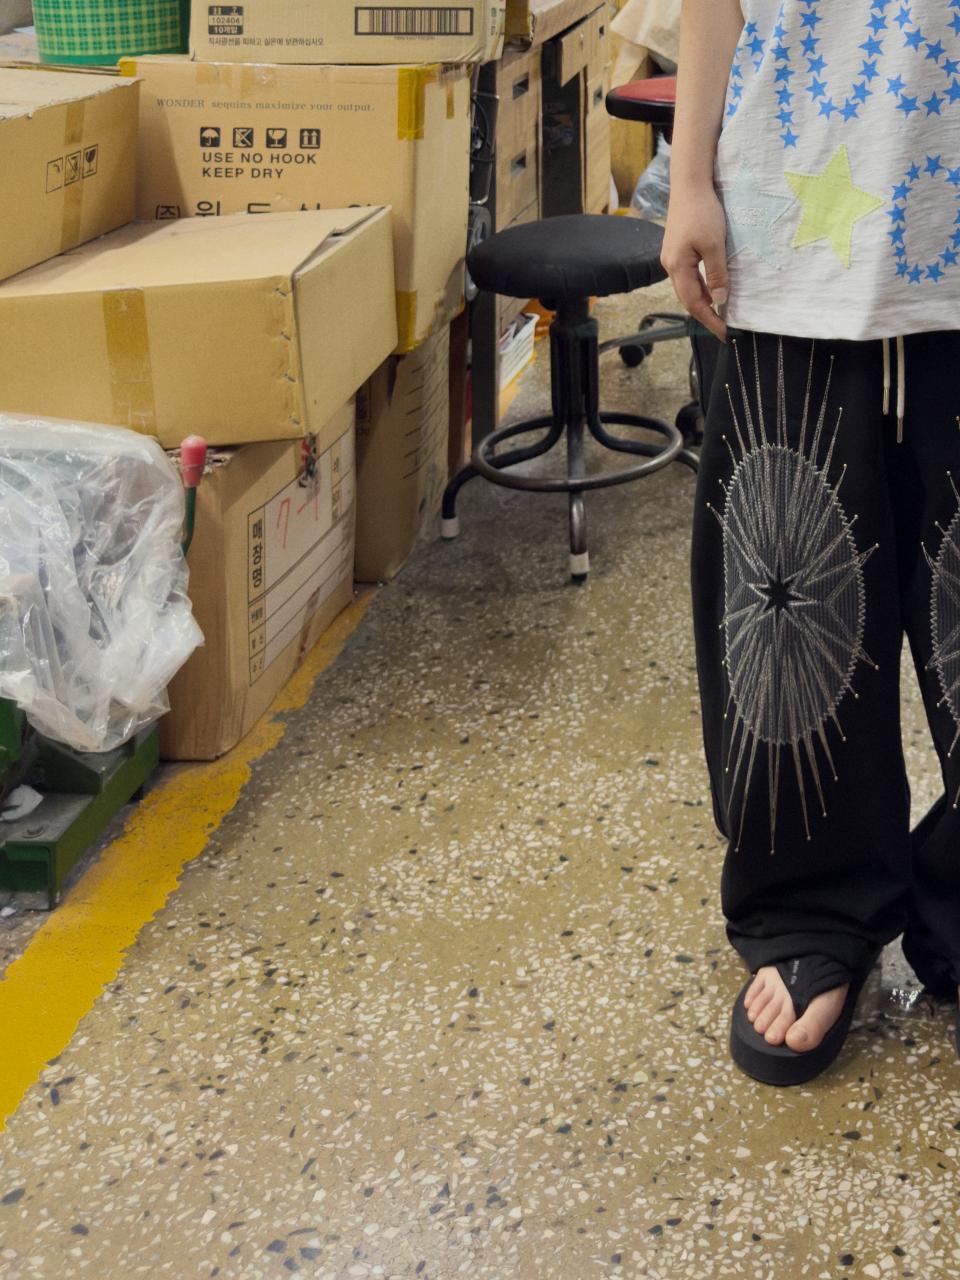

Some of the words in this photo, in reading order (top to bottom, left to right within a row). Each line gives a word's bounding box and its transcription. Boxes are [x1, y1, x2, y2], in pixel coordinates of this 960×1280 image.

[157, 98, 205, 109] WONDER
[256, 101, 306, 110] maximize
[310, 103, 333, 112] your
[202, 152, 234, 163] USE
[241, 153, 263, 163] NO
[270, 153, 317, 164] HOOK
[202, 167, 244, 178] KEEP
[251, 168, 284, 178] DRY
